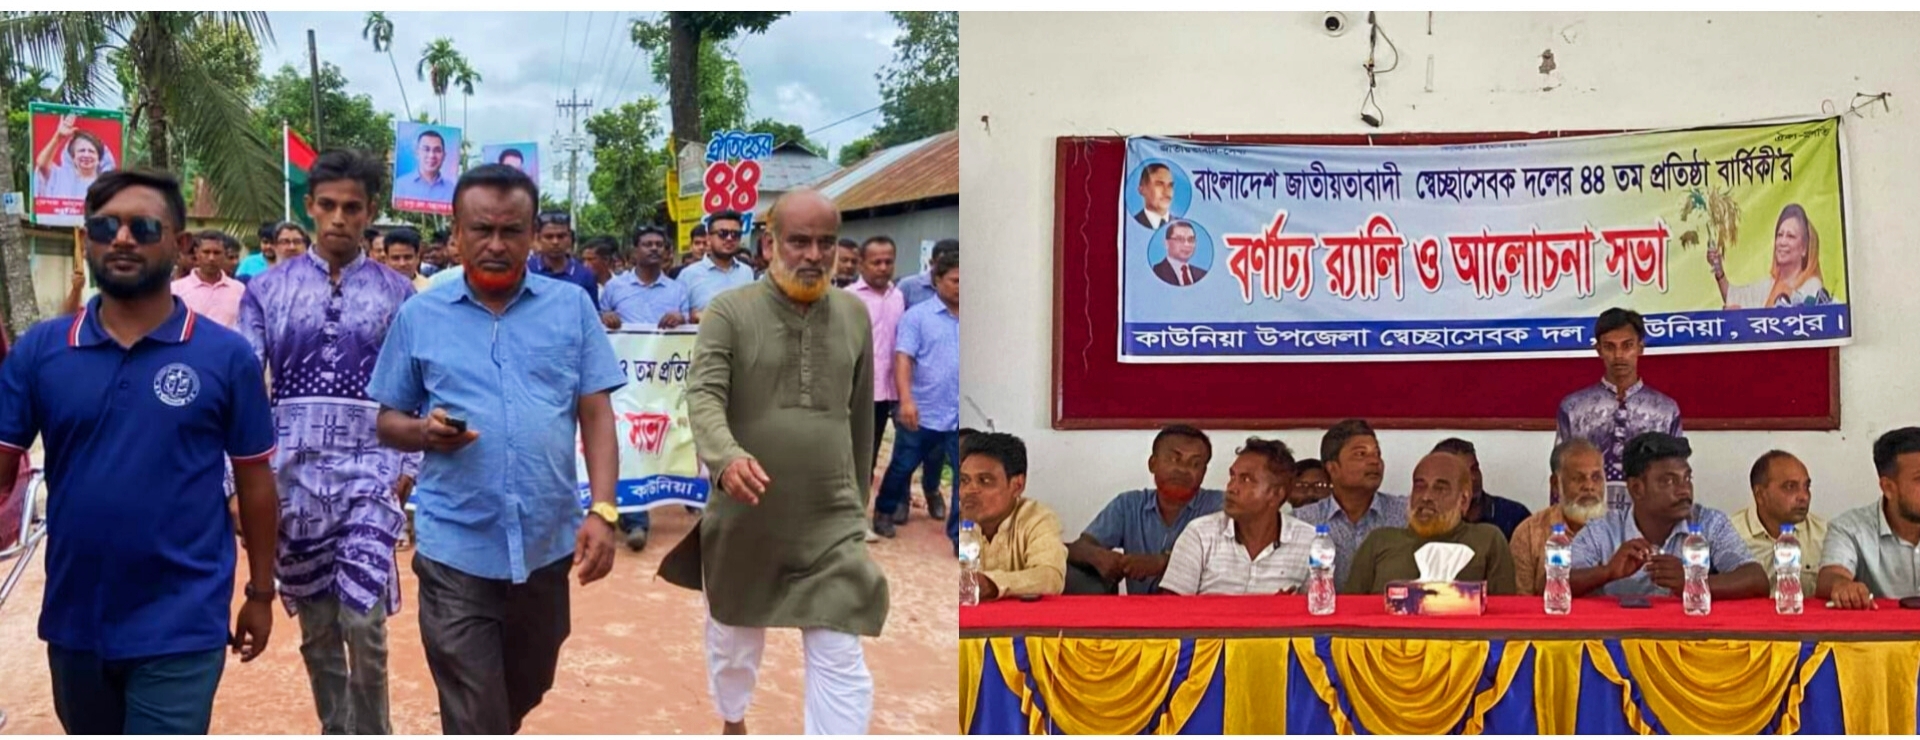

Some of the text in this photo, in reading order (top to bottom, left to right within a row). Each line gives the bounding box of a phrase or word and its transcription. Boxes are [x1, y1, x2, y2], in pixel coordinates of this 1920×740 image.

[703, 160, 762, 215] ৪৪
[1192, 168, 1279, 201] বাংলাদেশ
[1284, 161, 1402, 201] জাতীয়তাবাদী
[1416, 167, 1517, 202] স্বেচ্ছাসেবক
[1521, 167, 1574, 198] দলের
[1580, 165, 1605, 195] ৪৪
[1612, 164, 1645, 193] তম
[1650, 148, 1710, 192] প্রতিষ্ঠা
[1225, 211, 1317, 302] বর্ণাঢ্য
[1413, 238, 1441, 291] ও
[1448, 225, 1597, 299] আলোচনা
[1601, 220, 1671, 293] সভা
[1132, 325, 1248, 348] কাউনিয়া
[1254, 325, 1371, 347] উপজেলা
[1380, 326, 1532, 348] স্বেচ্ছাসেবক
[624, 412, 670, 455] সভা
